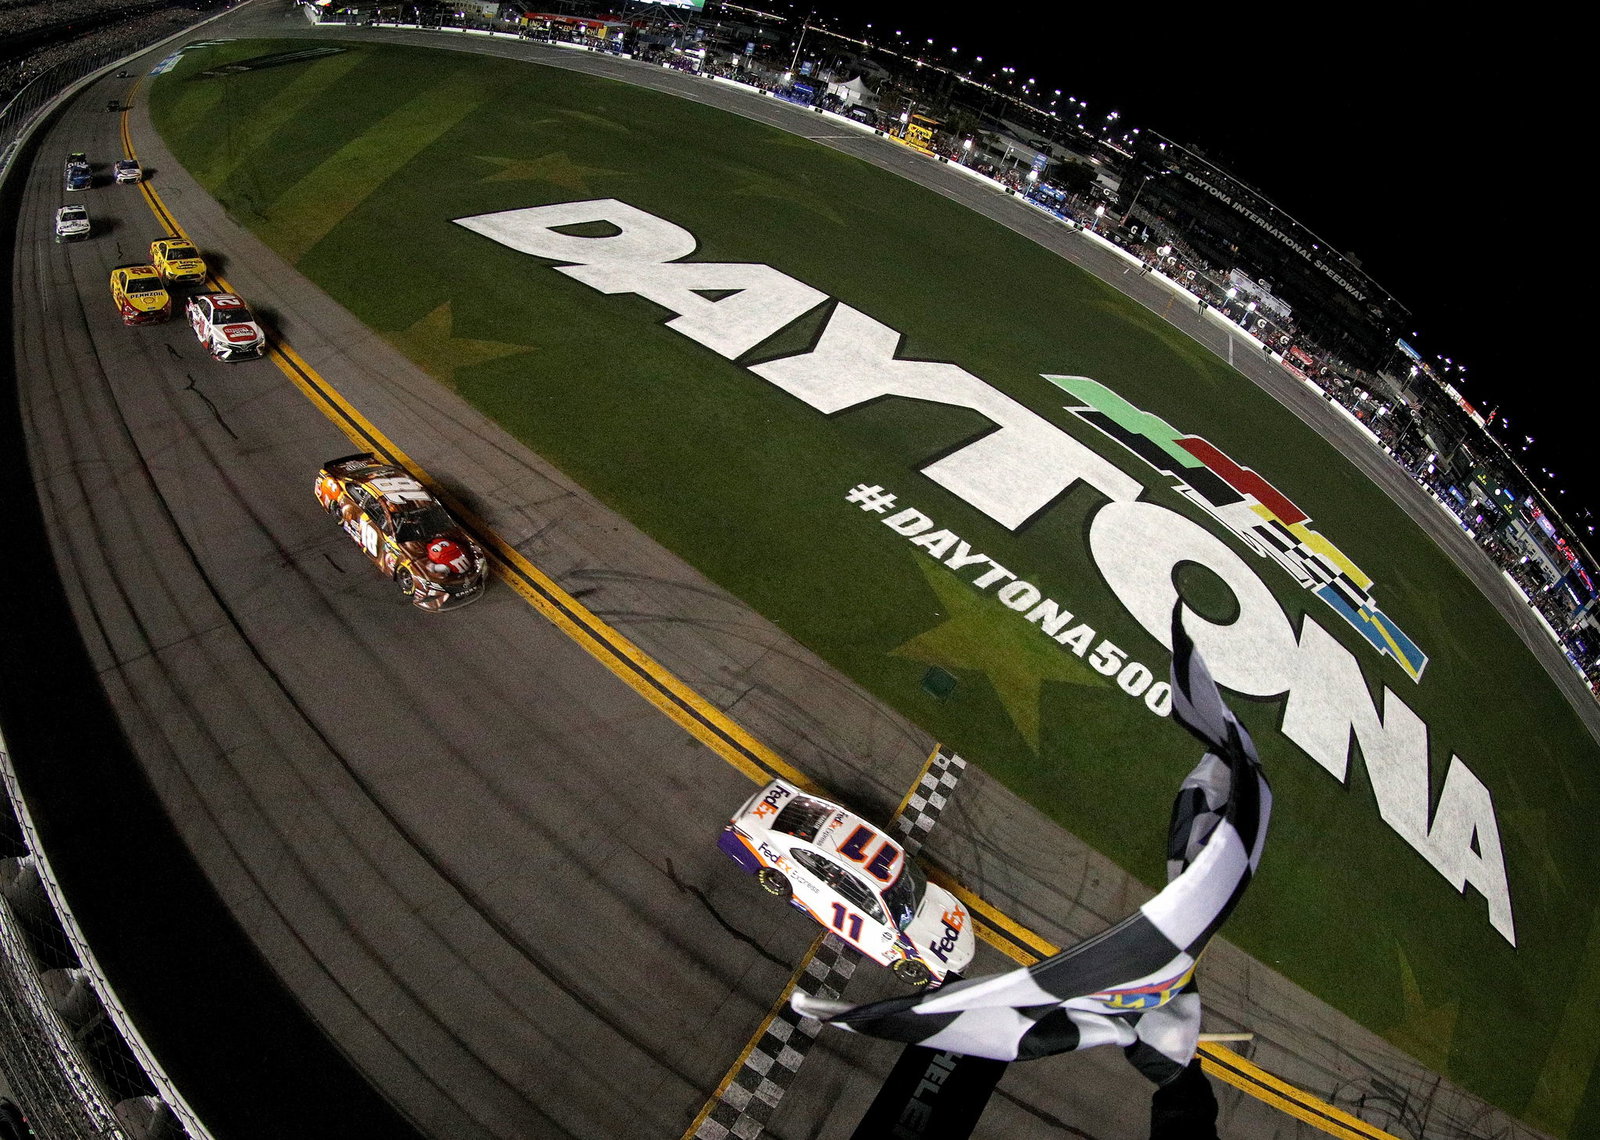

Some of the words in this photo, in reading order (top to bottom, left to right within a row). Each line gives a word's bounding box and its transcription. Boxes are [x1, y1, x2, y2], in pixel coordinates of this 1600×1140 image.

[1184, 172, 1232, 205] DAYTONA
[1232, 202, 1312, 262] INTERNATIONAL
[1314, 259, 1367, 302] SPEEDWAY
[129, 291, 165, 300] PENNZOIL
[360, 520, 378, 557] 18
[451, 199, 1517, 949] DAYTONA
[845, 483, 1173, 717] #DAYTONA500
[753, 785, 791, 819] FedEx
[829, 811, 849, 829] FedEx
[758, 842, 792, 874] FedEx
[791, 870, 820, 894] Express
[836, 824, 900, 882] 11
[831, 902, 864, 942] 11
[930, 904, 966, 963] FedEx
